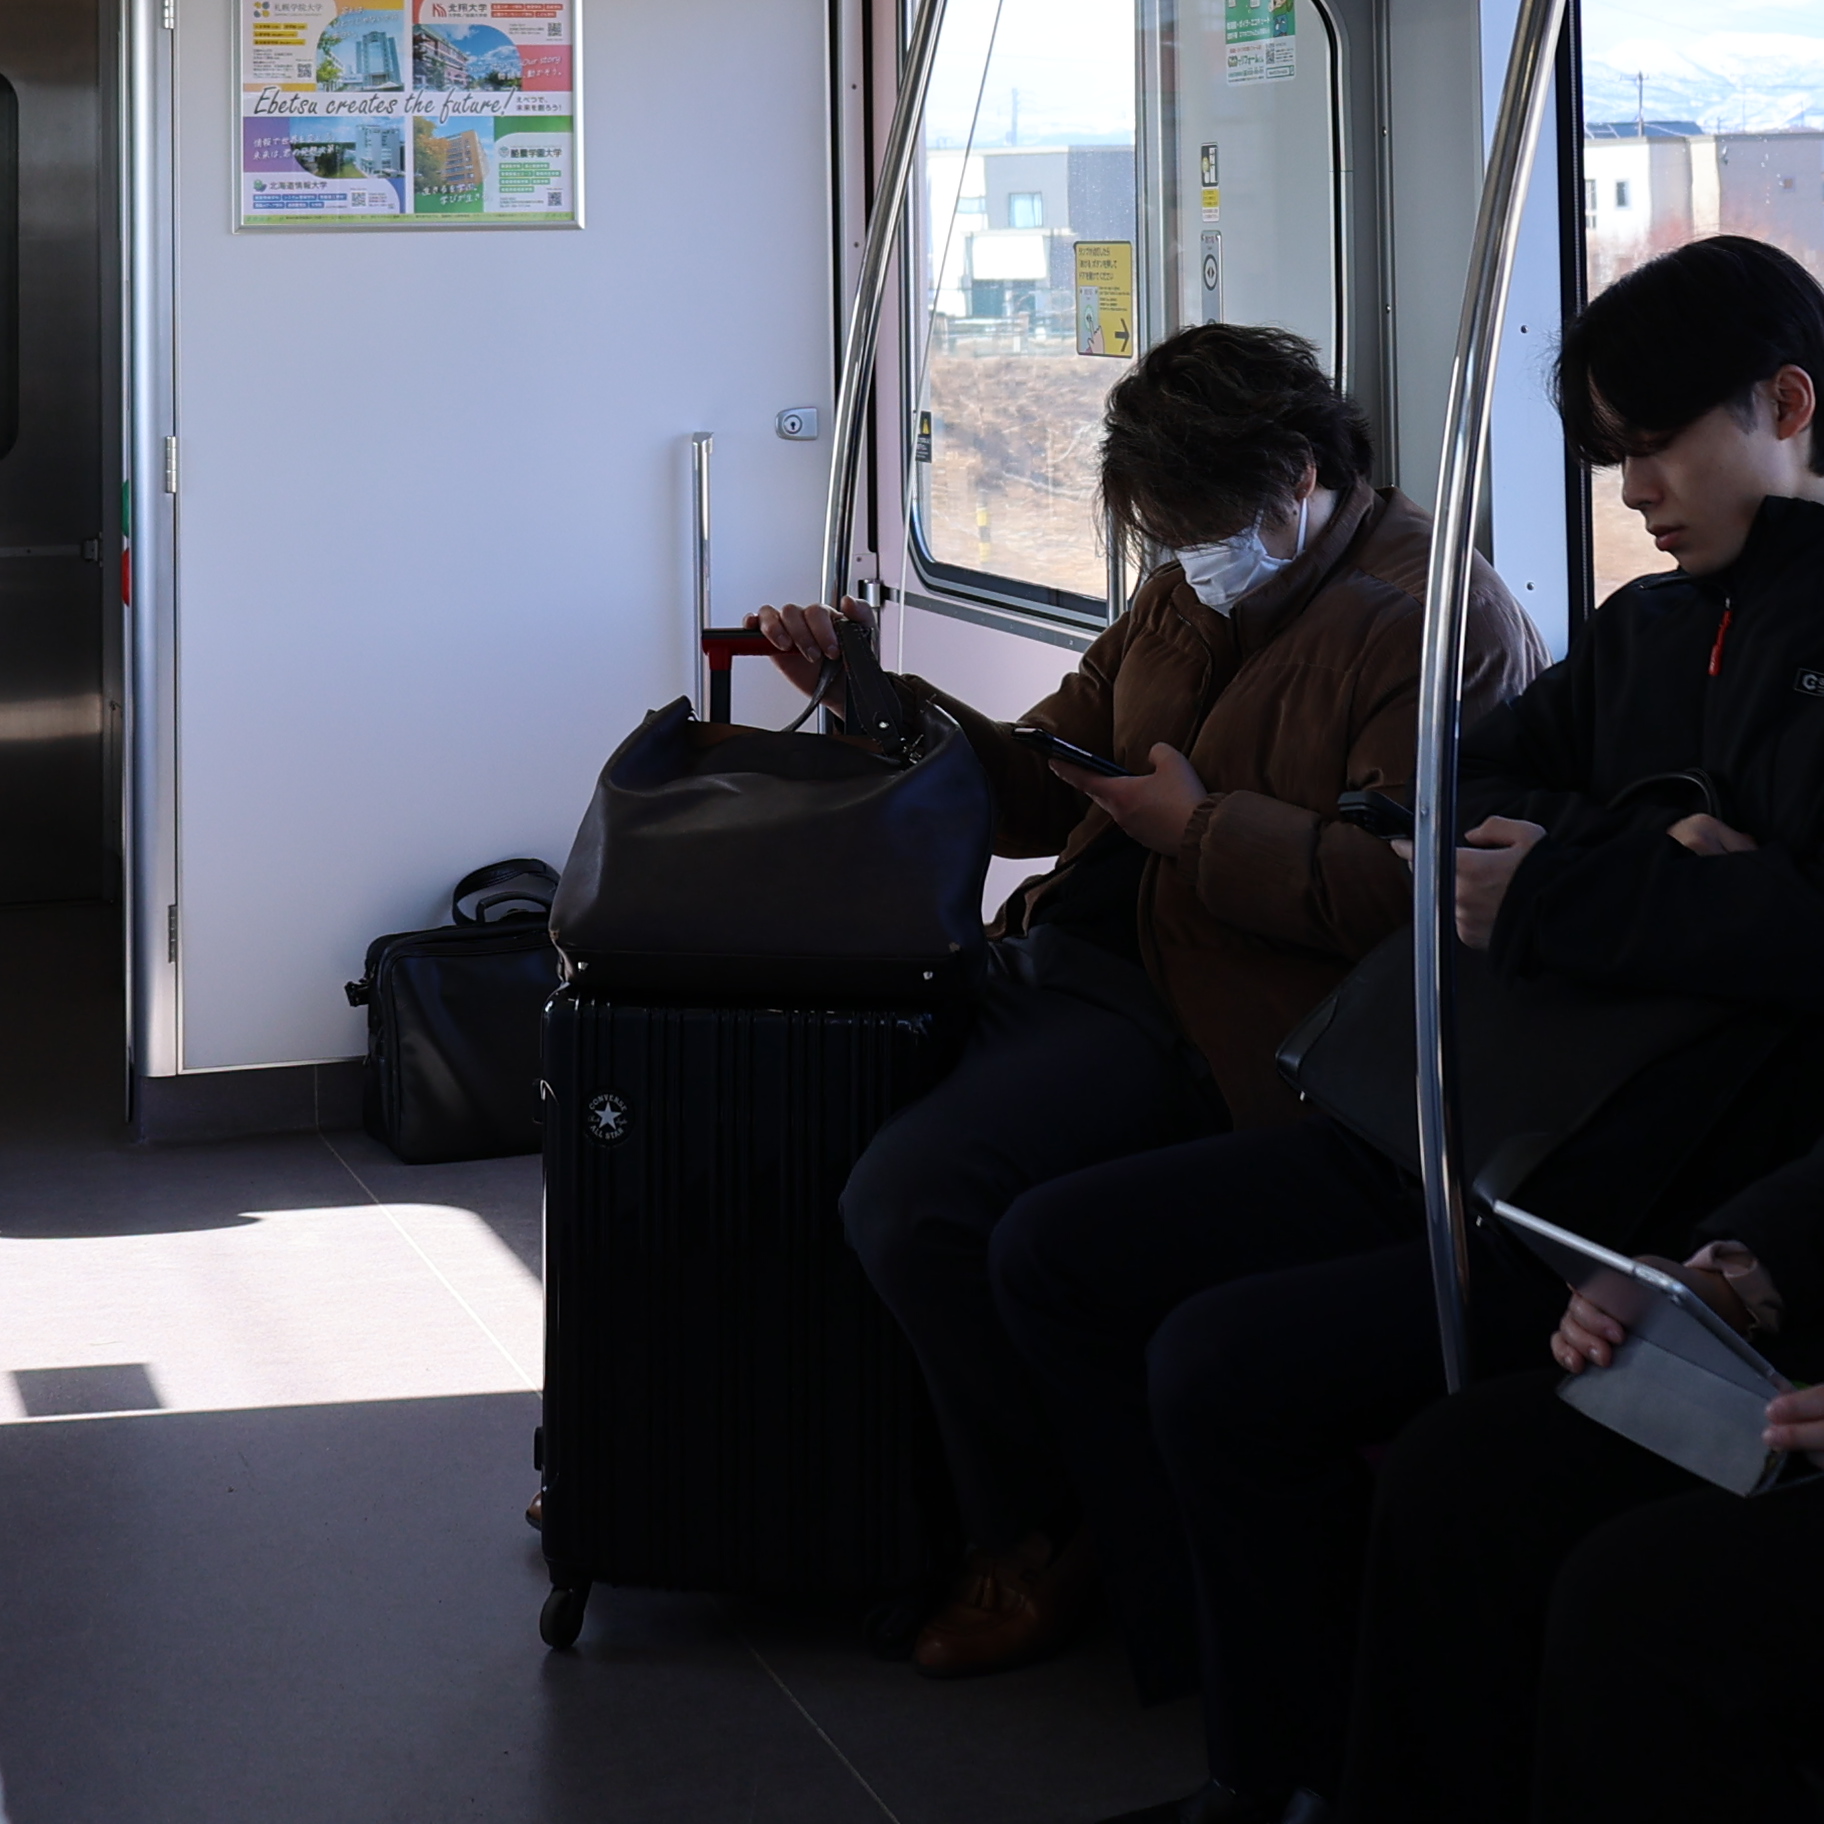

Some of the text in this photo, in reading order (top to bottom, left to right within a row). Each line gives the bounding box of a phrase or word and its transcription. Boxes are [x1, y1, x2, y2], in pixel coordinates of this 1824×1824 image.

[448, 3, 487, 13] 北翔大学
[253, 86, 516, 124] Ebetsu creates the future!
[269, 181, 327, 191] 北海道情報大学
[588, 1093, 628, 1111] CONVERSE
[589, 1124, 625, 1140] ALL STAR
